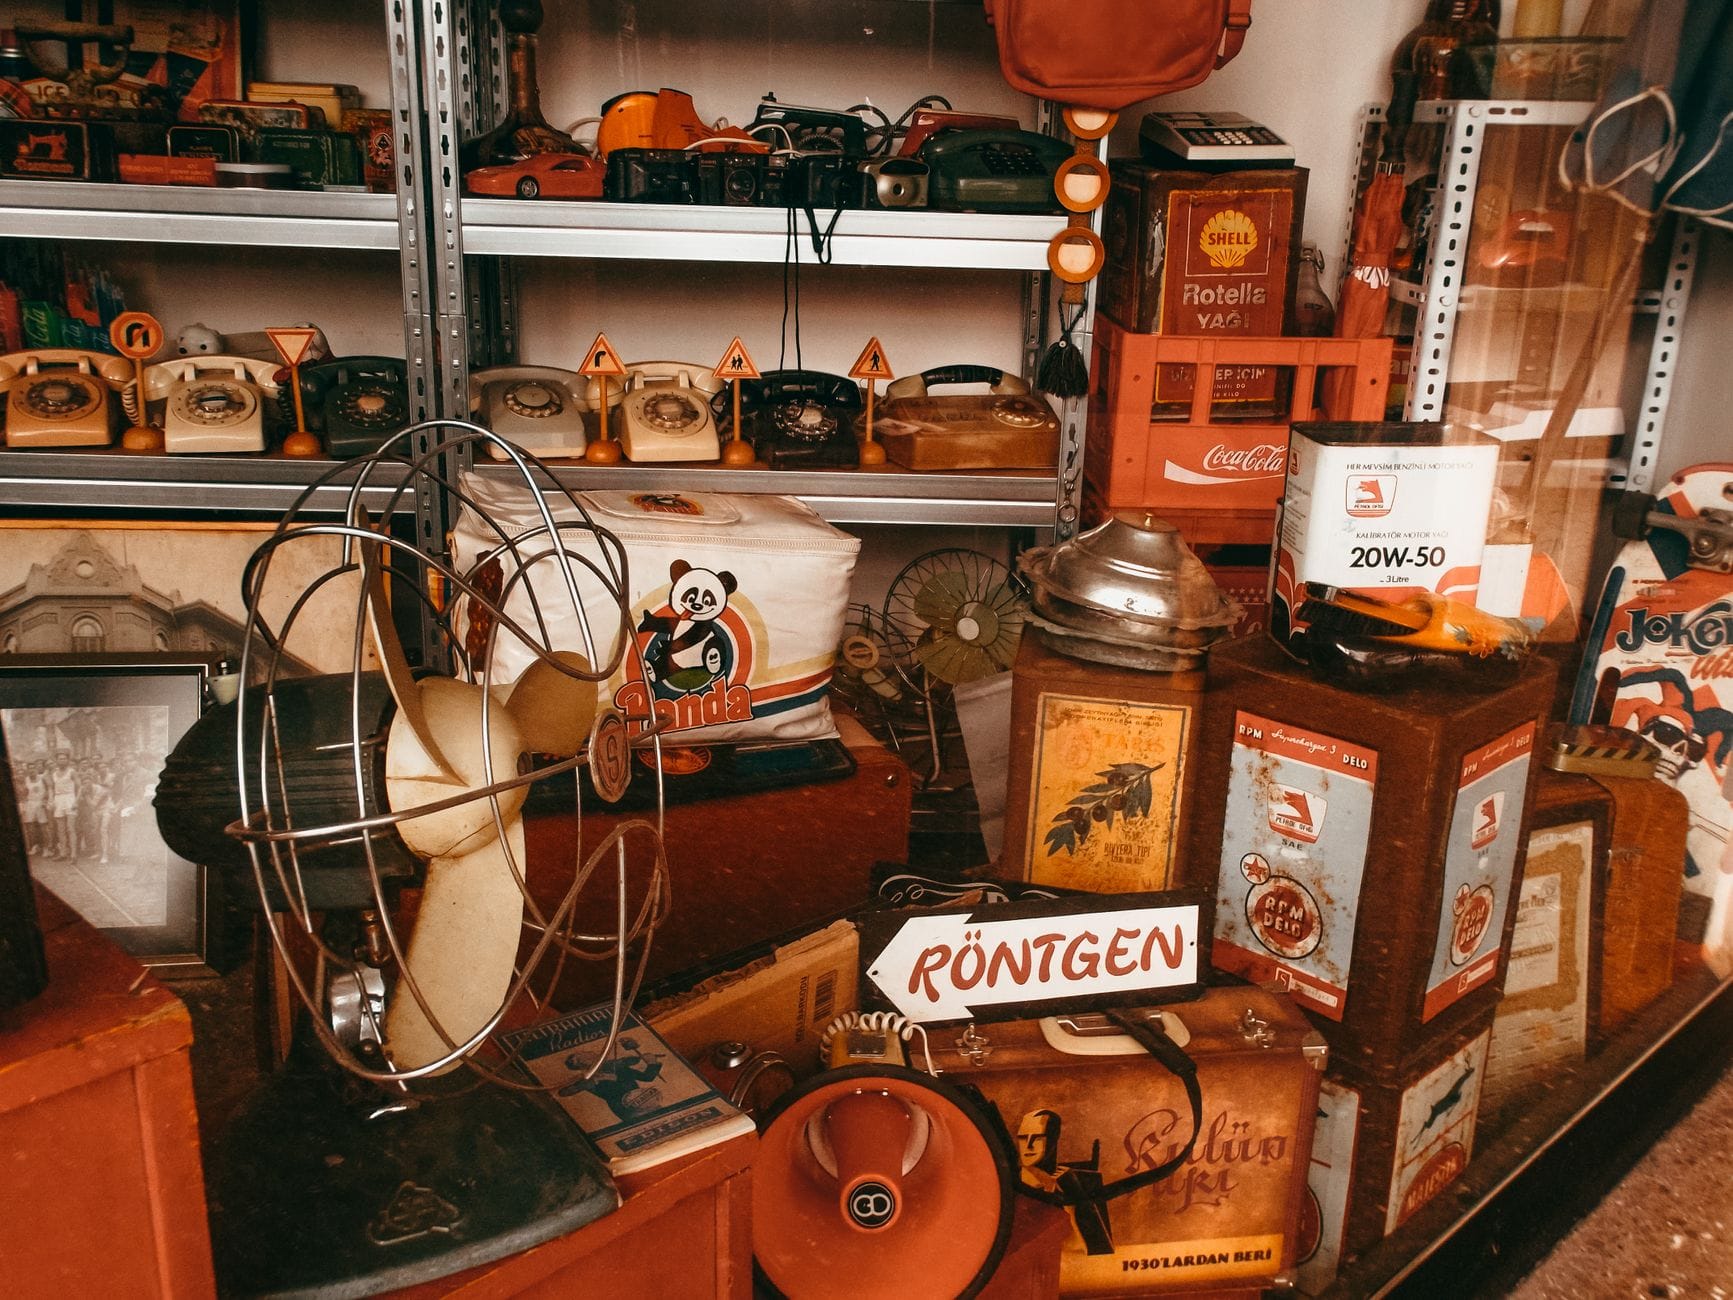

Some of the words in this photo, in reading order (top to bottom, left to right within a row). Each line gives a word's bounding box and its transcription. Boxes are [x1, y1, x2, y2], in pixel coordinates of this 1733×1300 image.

[1208, 232, 1251, 246] SHELL
[1183, 282, 1266, 306] Rotella
[1197, 309, 1249, 329] YAĞI
[1403, 530, 1430, 539] MOTOR
[1349, 546, 1446, 568] 20W-50
[1392, 575, 1410, 583] Litre
[614, 675, 754, 736] Panda
[1239, 724, 1263, 740] RPM
[1271, 728, 1328, 754] Supercharged
[1342, 752, 1368, 769] DELO
[1281, 837, 1303, 851] SAE
[1265, 896, 1304, 922] RPM
[1263, 911, 1301, 937] DELO
[908, 924, 1184, 1003] RÖNTGEN
[1122, 1253, 1229, 1272] 1930'LARDAN
[1233, 1248, 1272, 1262] BERİ
